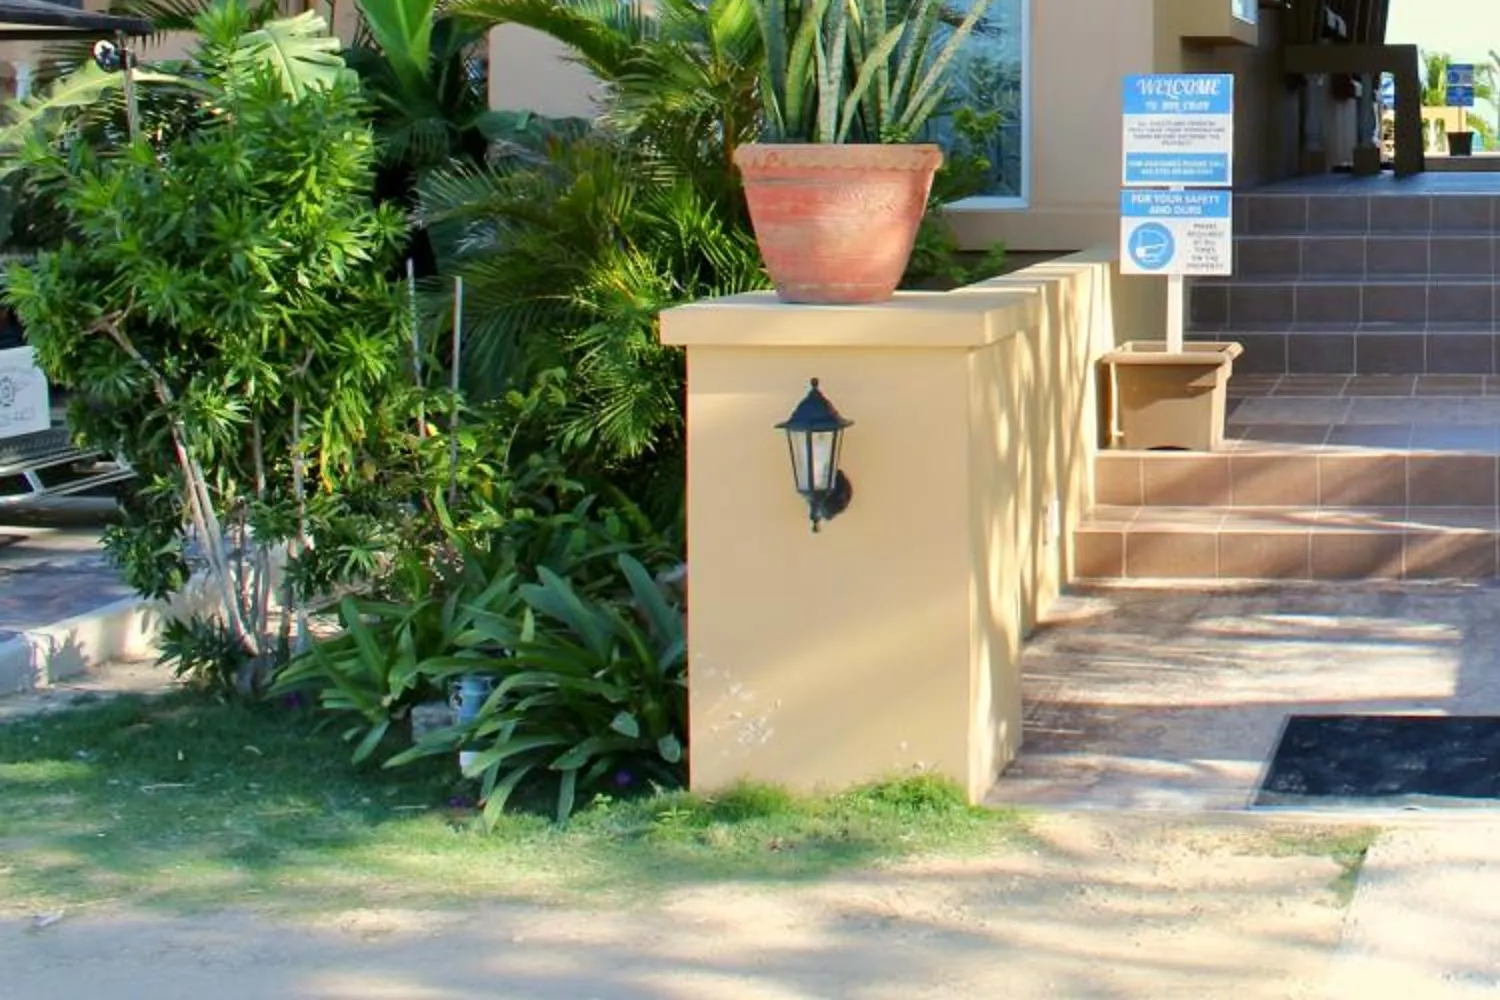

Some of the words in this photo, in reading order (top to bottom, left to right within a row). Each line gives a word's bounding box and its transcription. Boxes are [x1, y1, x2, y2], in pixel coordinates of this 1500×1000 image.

[1135, 78, 1221, 100] WELCOME
[1132, 194, 1151, 205] FOR
[1152, 193, 1184, 204] YOUR
[1185, 194, 1220, 204] SAFETY
[1148, 205, 1172, 215] AND
